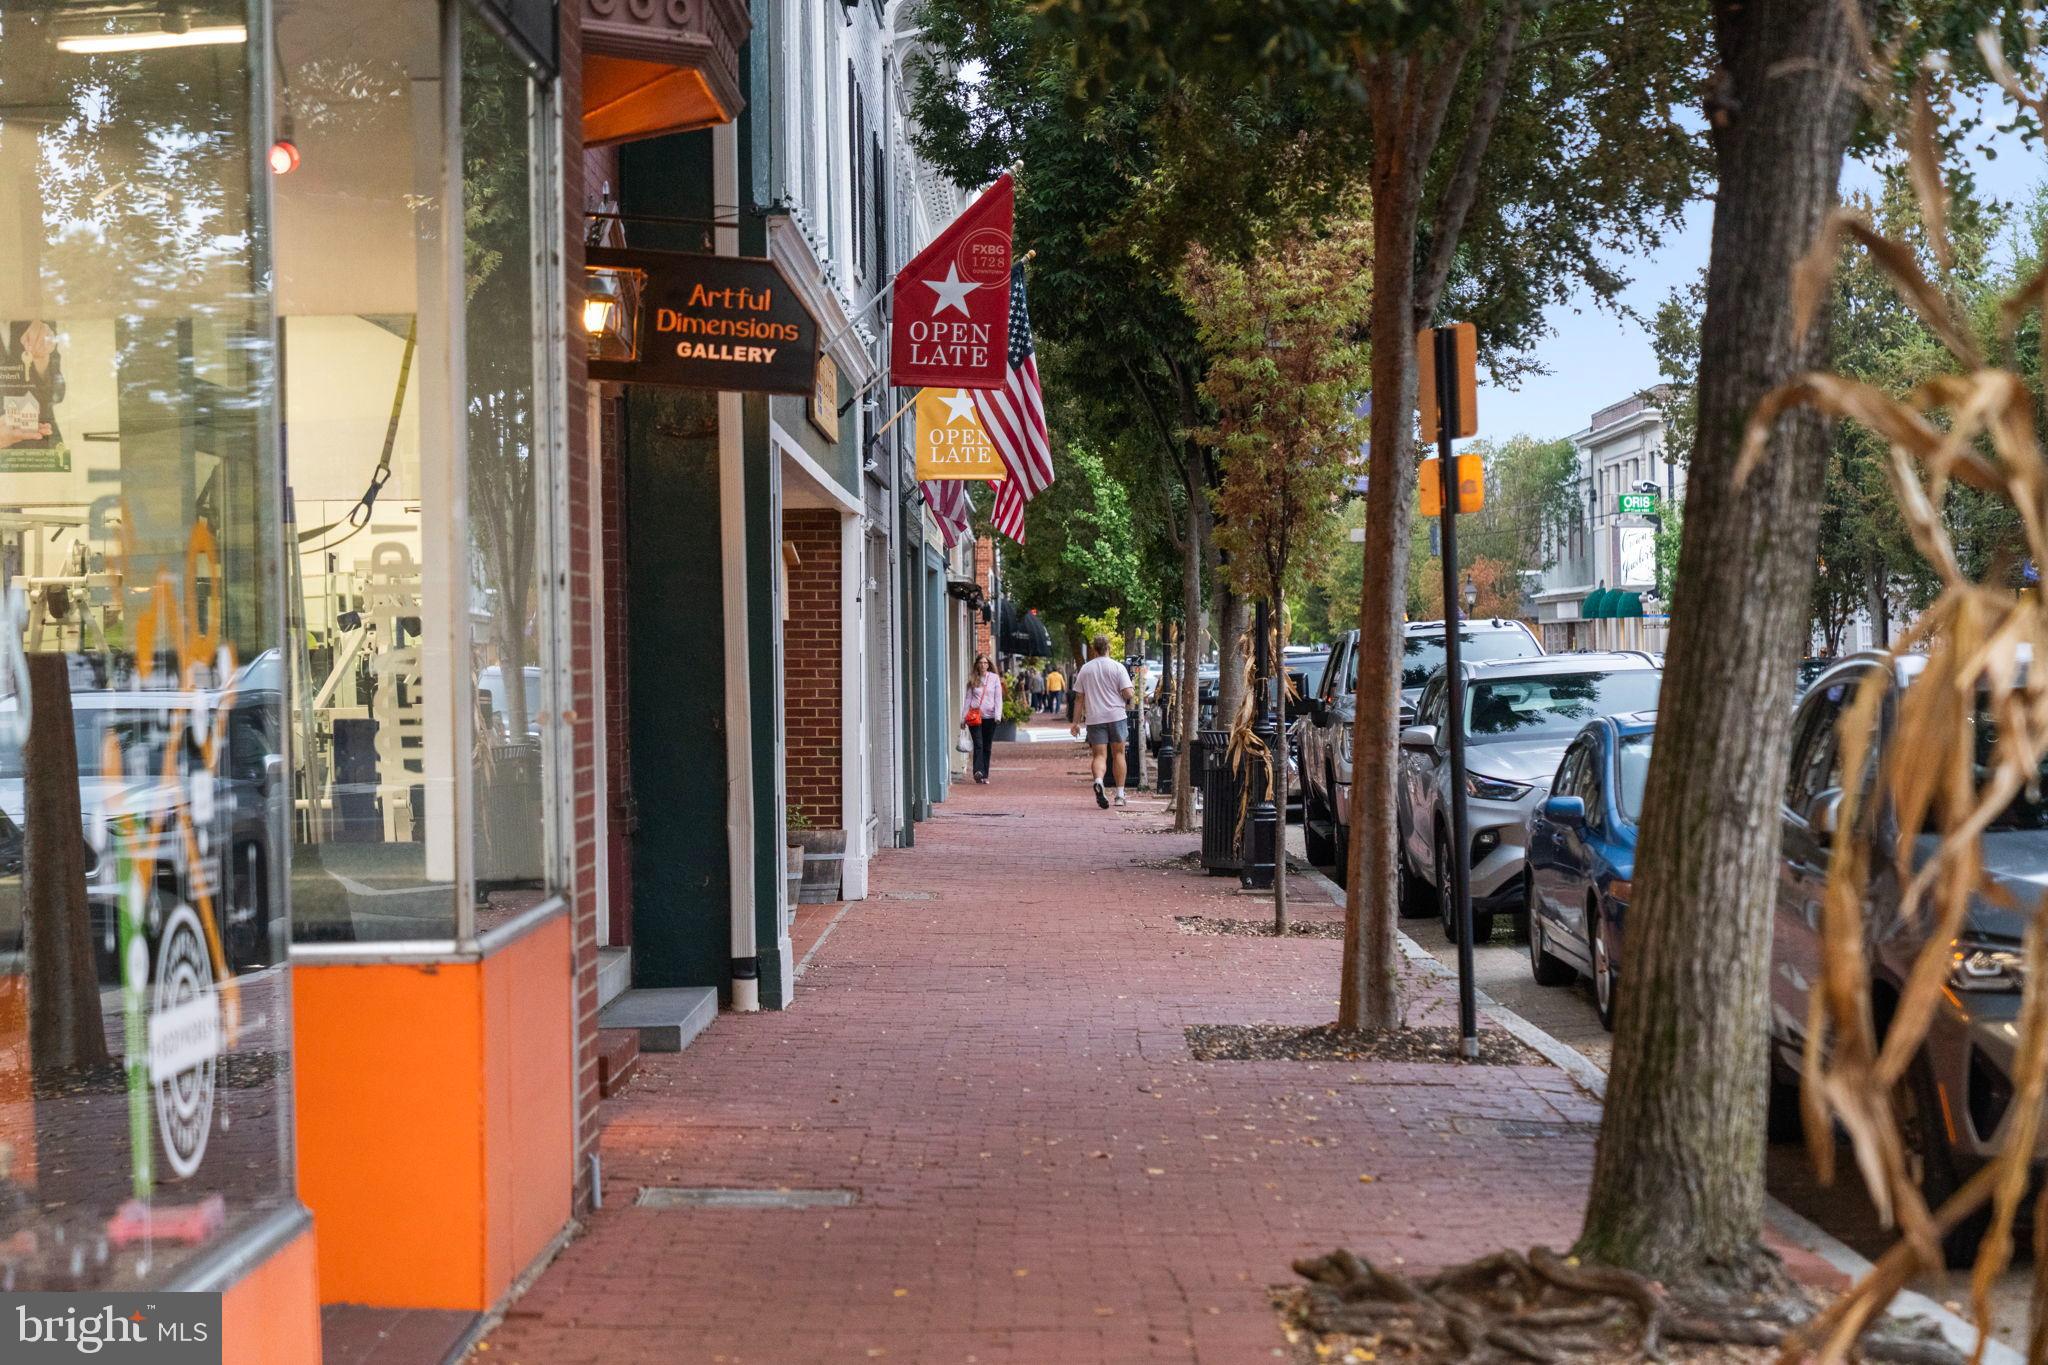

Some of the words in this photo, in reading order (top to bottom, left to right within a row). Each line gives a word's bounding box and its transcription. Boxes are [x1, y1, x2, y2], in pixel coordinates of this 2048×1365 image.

[972, 244, 1005, 255] FXBG
[973, 256, 1005, 268] 1728
[688, 283, 772, 312] Artful
[656, 308, 800, 341] Dimensions
[909, 320, 992, 344] OPEN
[676, 341, 777, 364] GALLERY
[909, 343, 988, 367] LATE
[929, 428, 991, 445] OPEN
[930, 446, 991, 463] LATE
